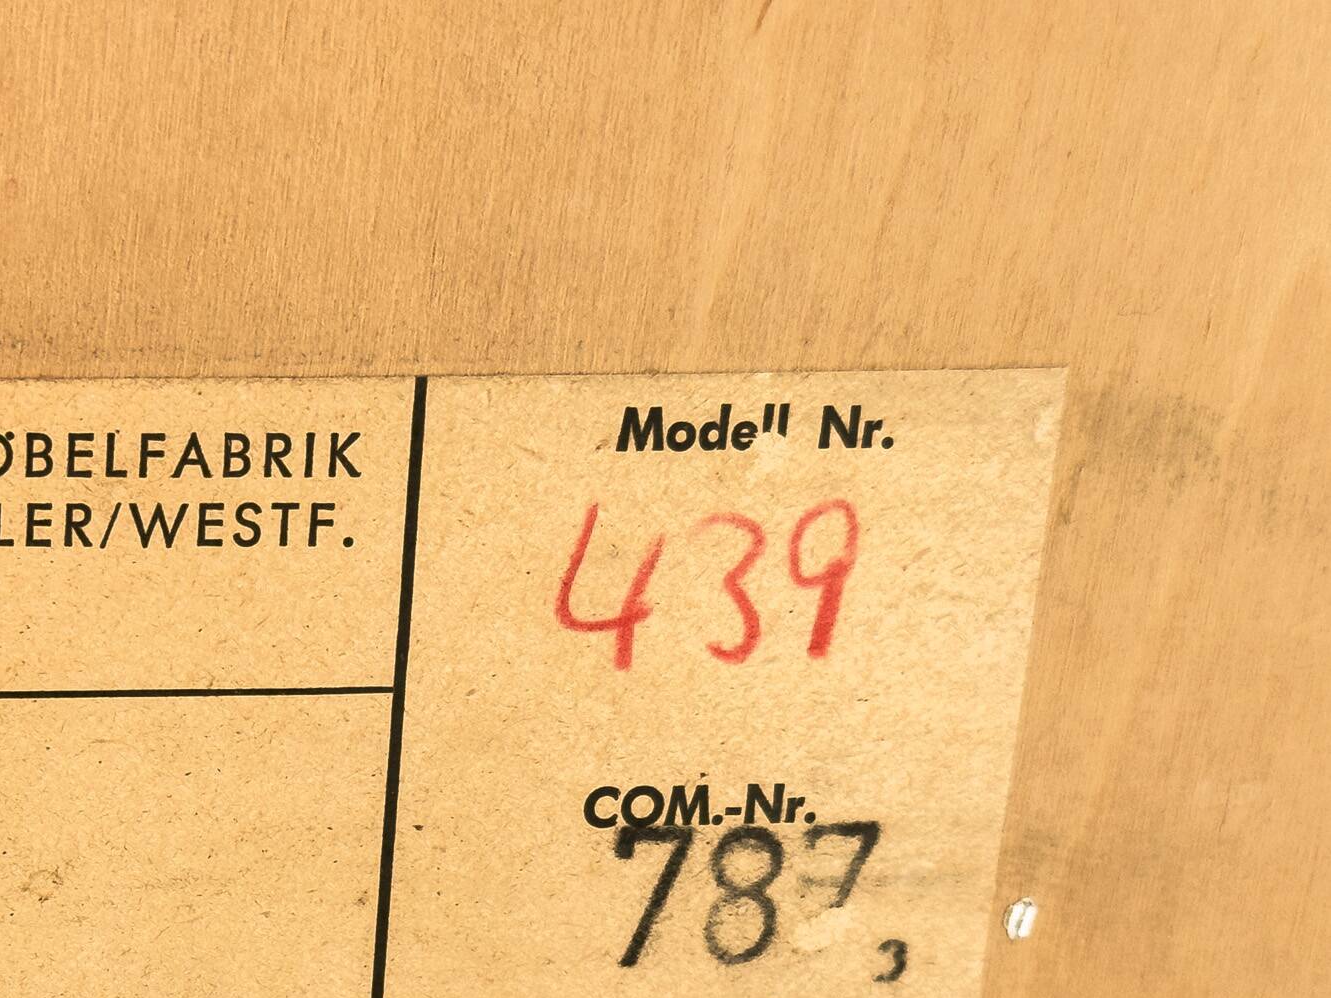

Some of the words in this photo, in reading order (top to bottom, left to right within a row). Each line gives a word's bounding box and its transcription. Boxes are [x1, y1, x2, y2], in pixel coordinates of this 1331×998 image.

[816, 402, 898, 452] Nr.
[552, 498, 860, 674] 439
[582, 782, 818, 830] COM.-Nr.
